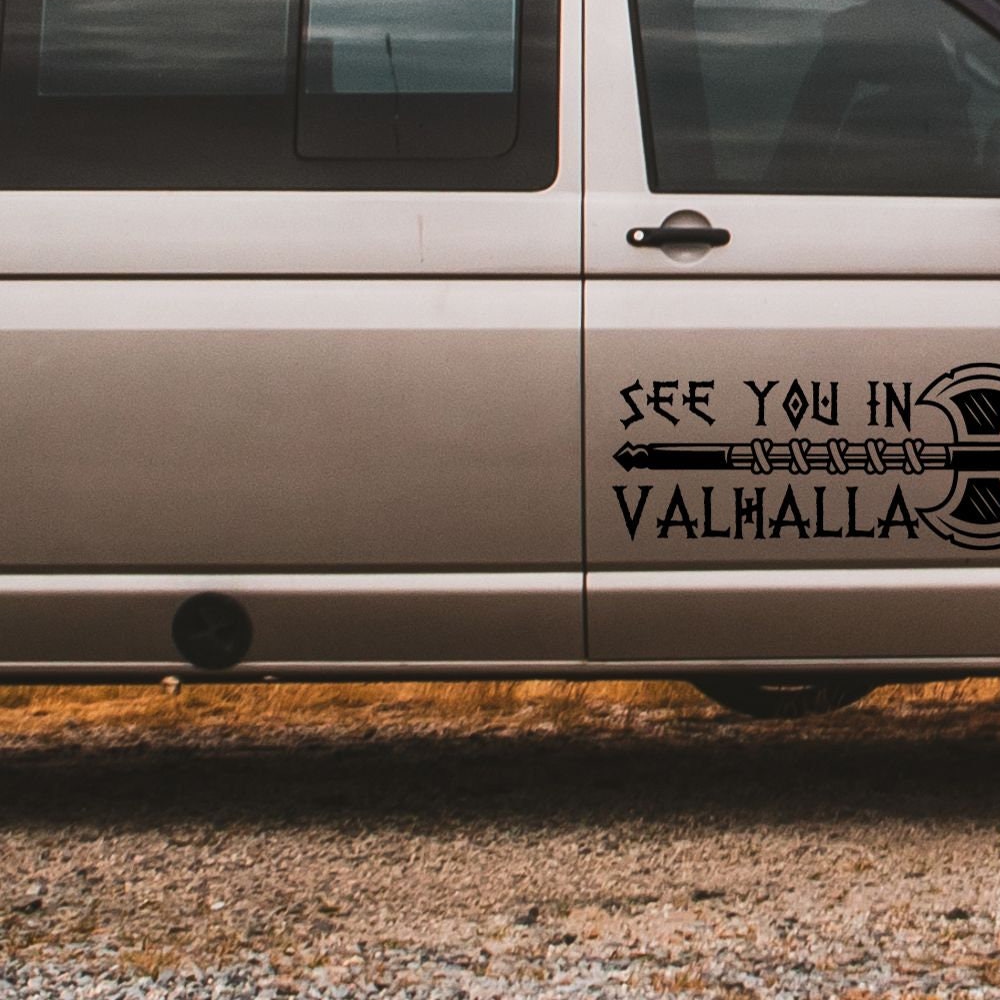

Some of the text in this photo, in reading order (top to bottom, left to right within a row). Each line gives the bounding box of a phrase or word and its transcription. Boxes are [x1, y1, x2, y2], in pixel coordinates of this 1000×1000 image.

[619, 378, 913, 433] SEE YOU IN
[612, 483, 920, 542] VALHALLA
